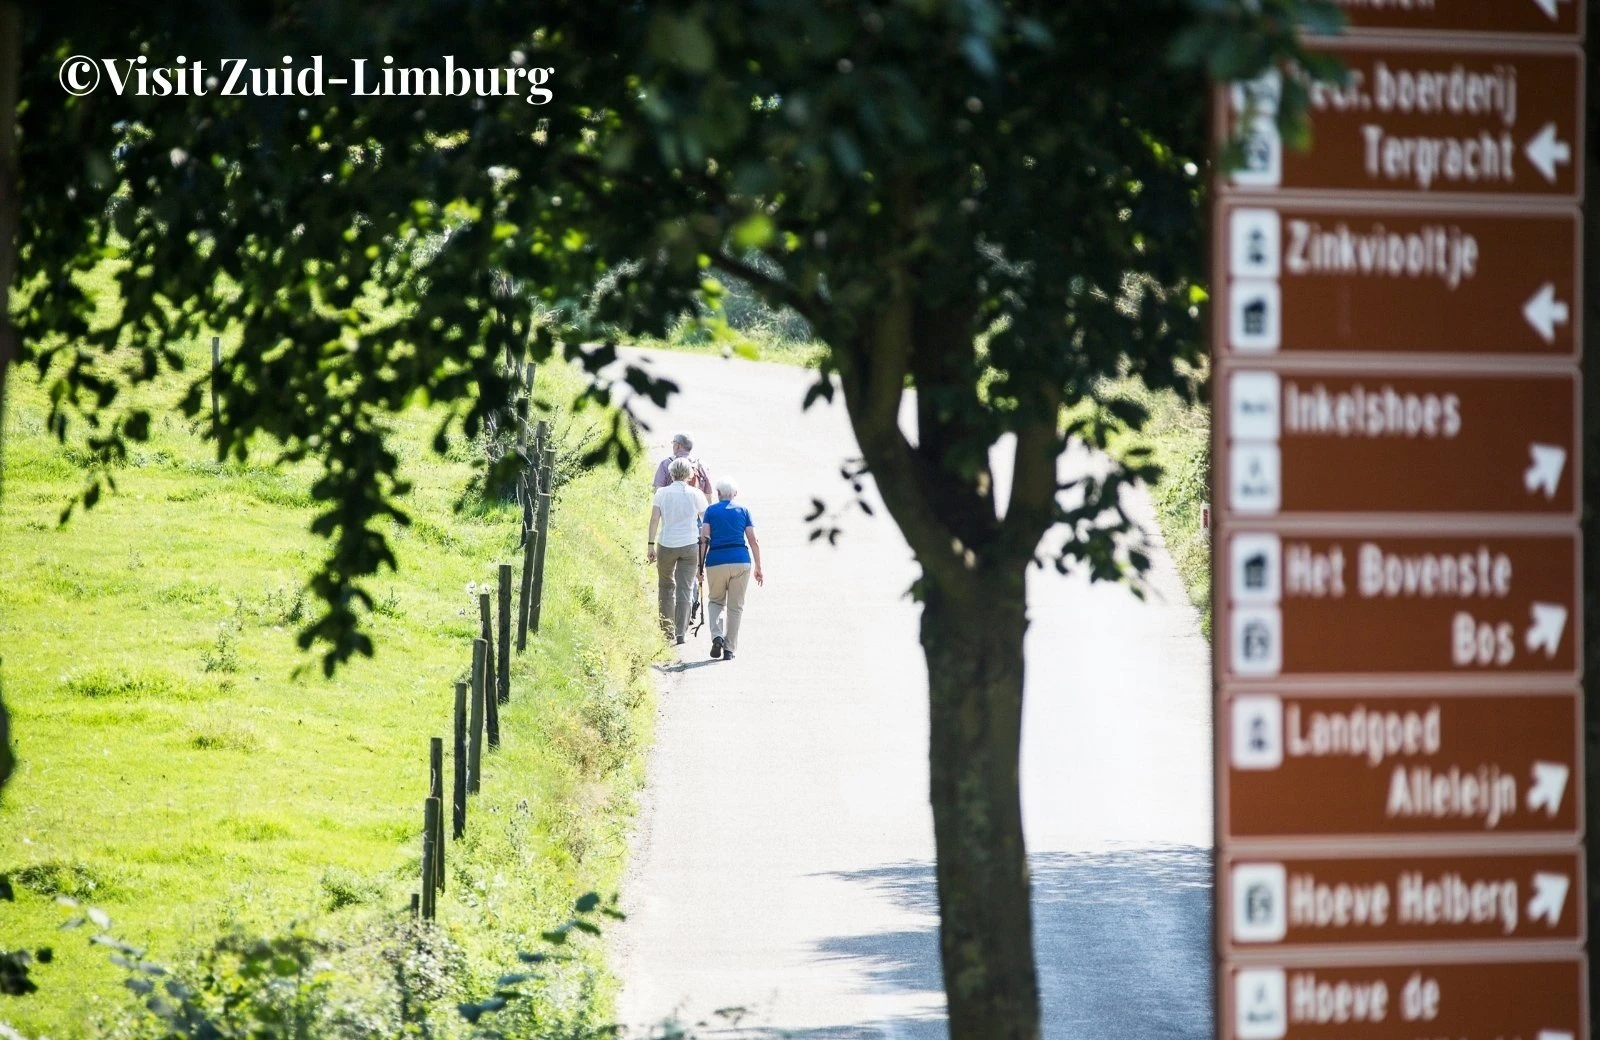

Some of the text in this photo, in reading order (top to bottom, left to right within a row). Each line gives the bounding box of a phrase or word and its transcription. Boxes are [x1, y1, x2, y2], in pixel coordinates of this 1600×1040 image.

[1375, 62, 1518, 128] boerderij
[1362, 124, 1515, 190] Tergracht
[1285, 220, 1479, 290] Zinkviooltje
[1284, 379, 1461, 437] Inkelshoes
[1285, 542, 1512, 598] Het Bovenste
[1451, 610, 1514, 666] Bos
[1285, 702, 1441, 768] Landgoed
[1386, 763, 1517, 830] Alleleijn
[1289, 868, 1519, 935] Hoeve Helberg
[1290, 971, 1440, 1026] Hoeve de
